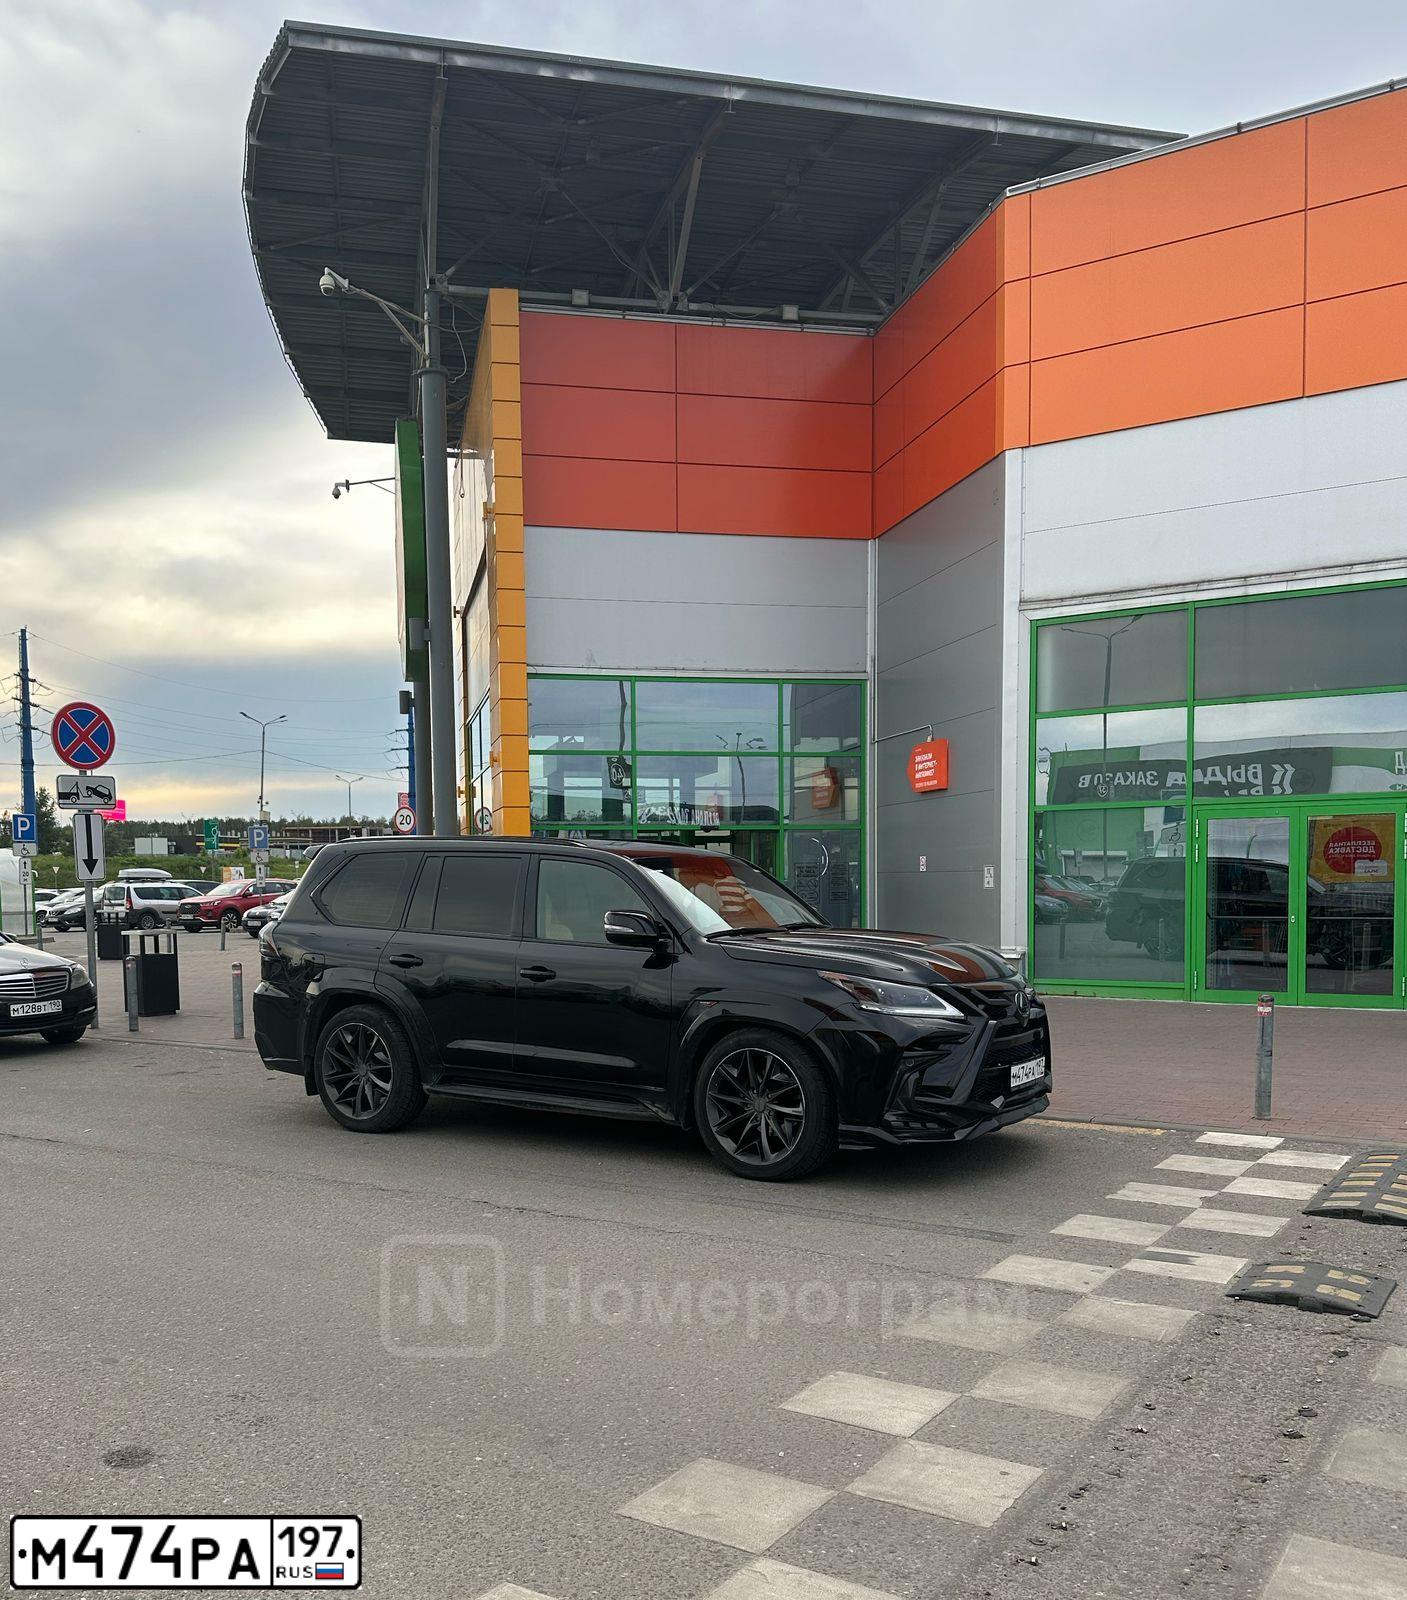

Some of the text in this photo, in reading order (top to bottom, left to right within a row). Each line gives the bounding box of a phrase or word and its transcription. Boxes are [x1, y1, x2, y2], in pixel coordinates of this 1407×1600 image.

[17, 816, 31, 839] P
[399, 814, 412, 826] 20
[253, 828, 265, 848] P
